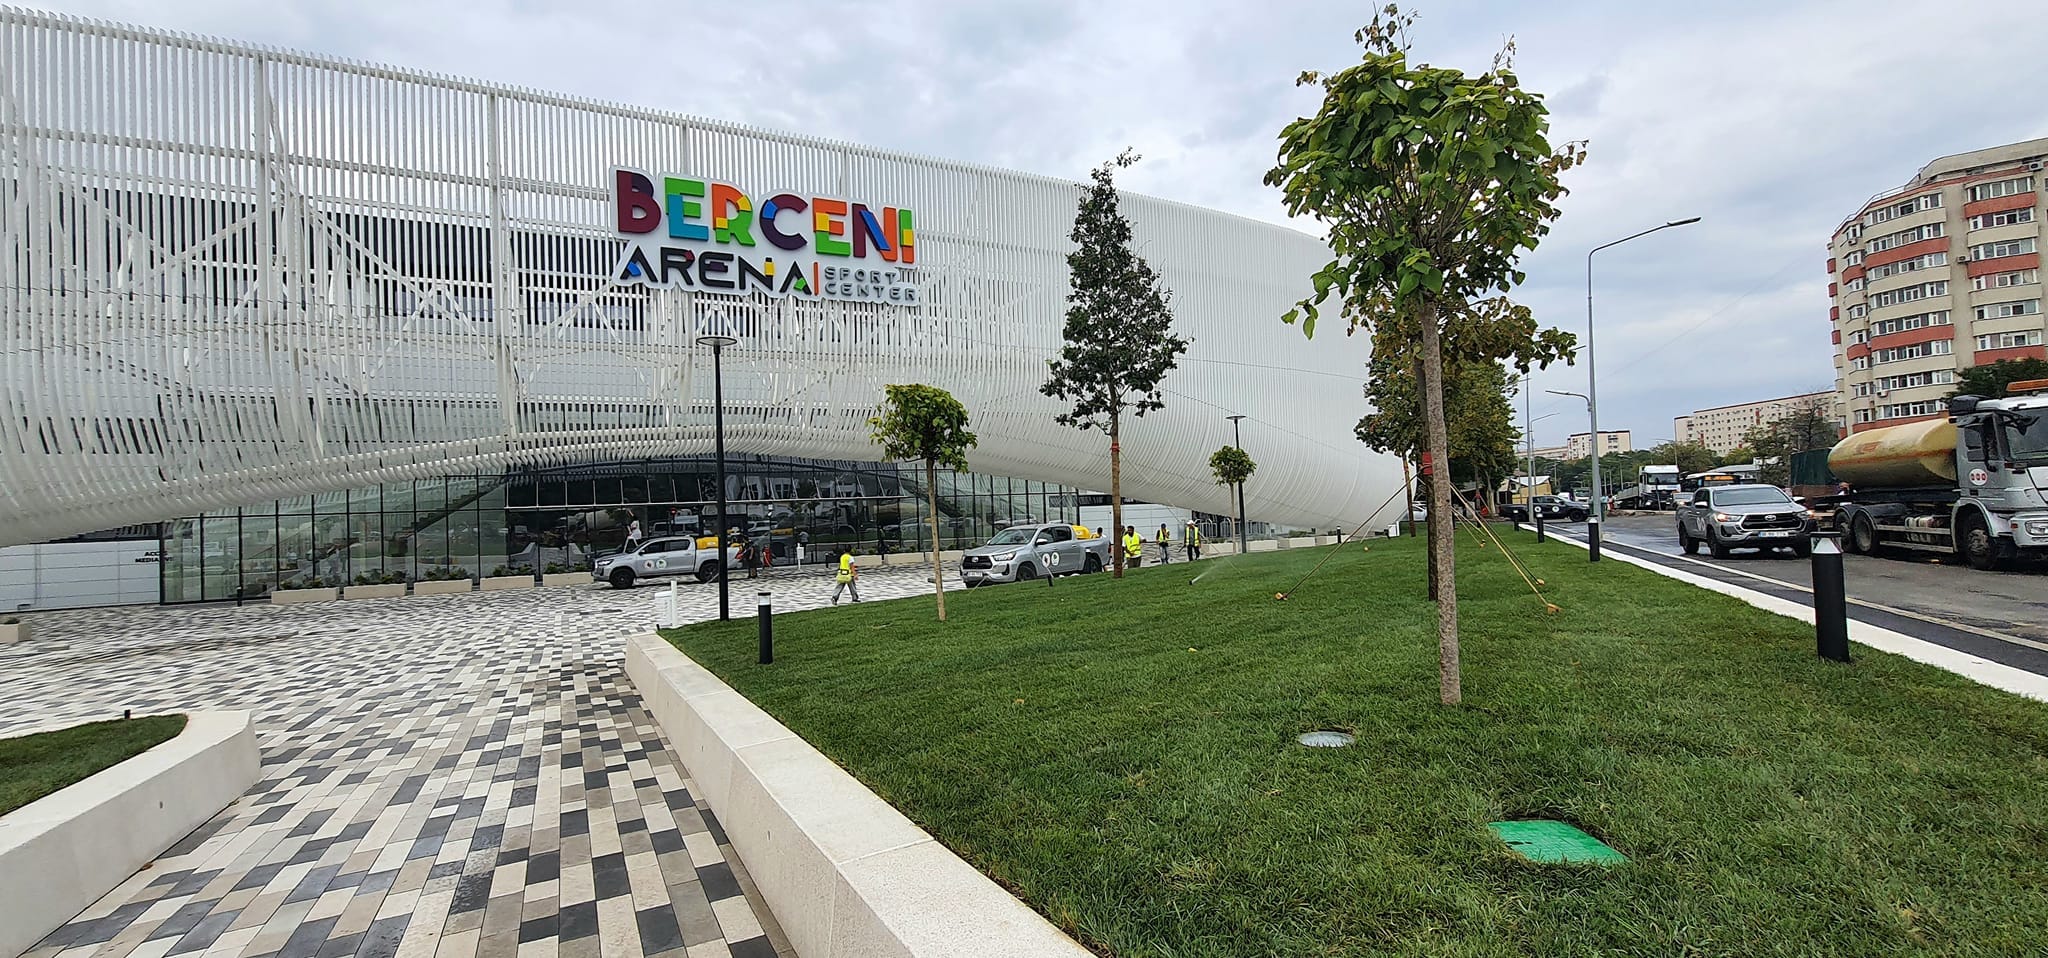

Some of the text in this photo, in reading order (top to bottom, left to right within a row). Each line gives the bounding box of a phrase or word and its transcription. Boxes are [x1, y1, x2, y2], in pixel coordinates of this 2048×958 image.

[616, 170, 915, 264] BERCENI
[620, 245, 812, 296] ARENA
[824, 266, 897, 285] SPORT
[825, 281, 916, 301] CENTER
